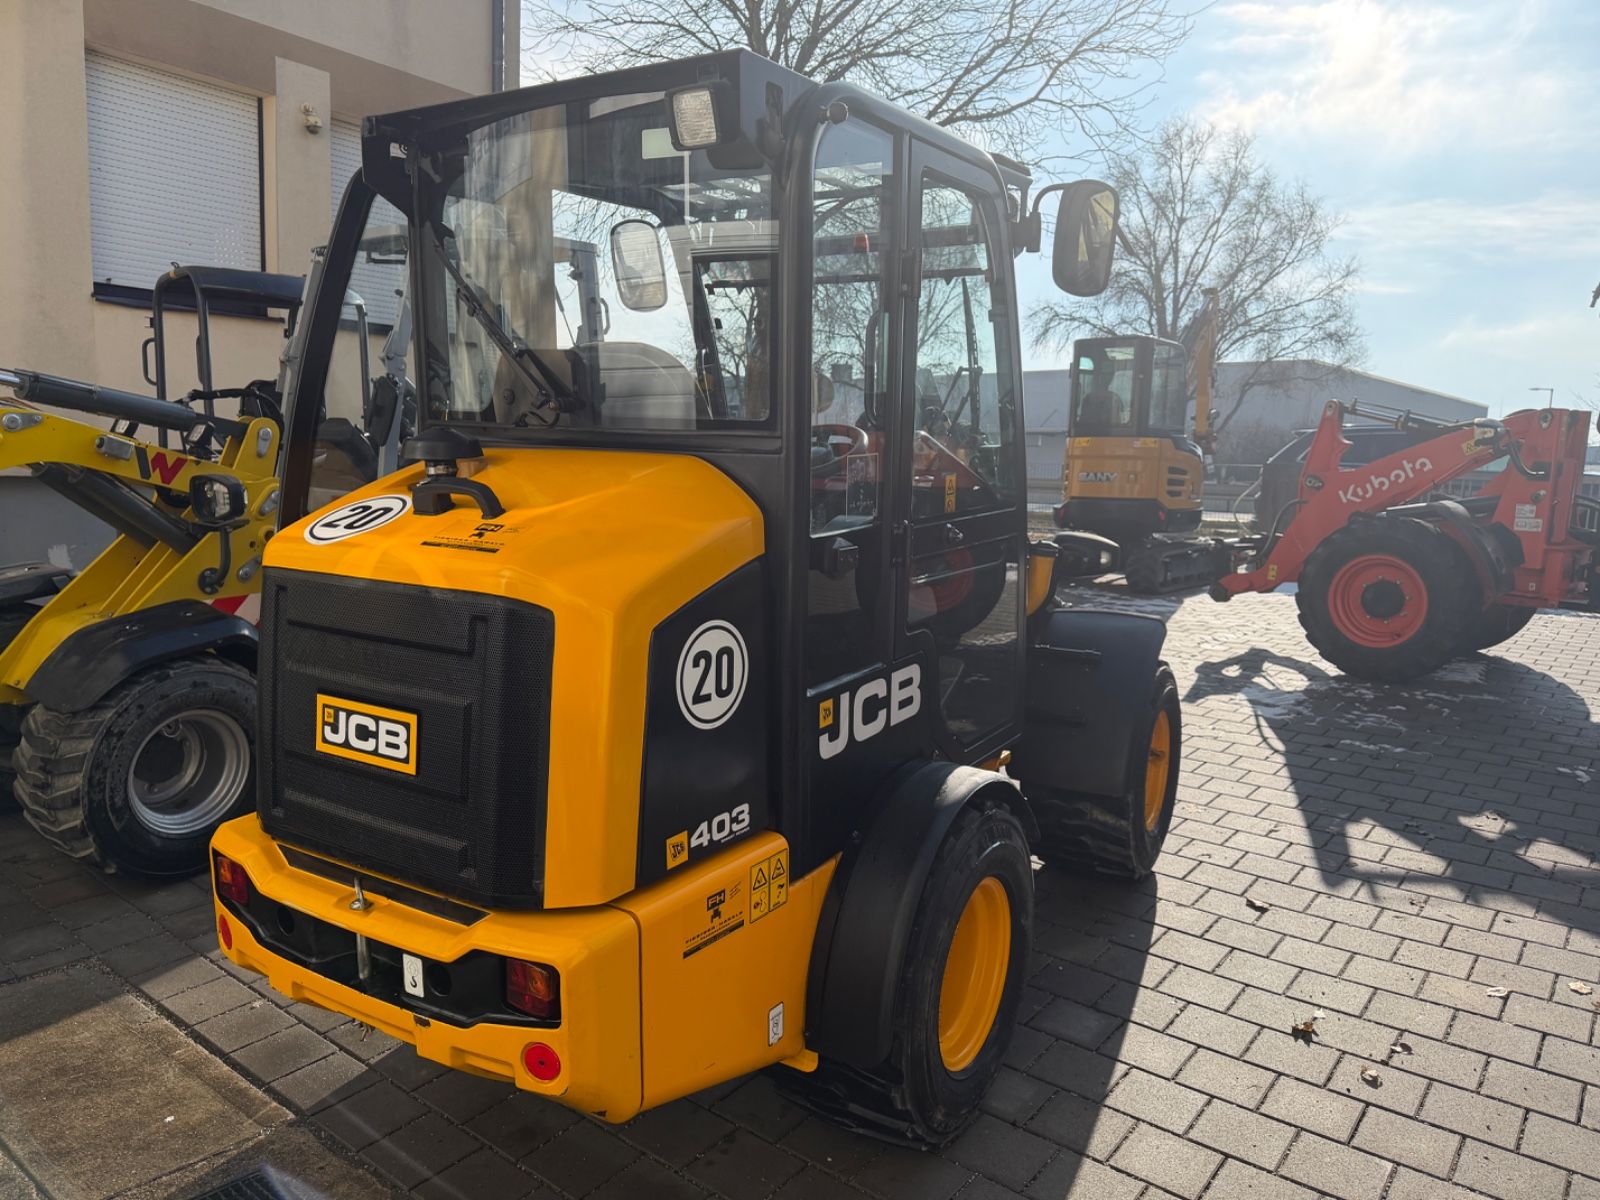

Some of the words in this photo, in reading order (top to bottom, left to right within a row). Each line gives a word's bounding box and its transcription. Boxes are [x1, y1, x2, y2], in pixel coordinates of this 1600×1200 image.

[1078, 472, 1118, 482] SANY
[1338, 457, 1432, 503] Kubota
[320, 505, 394, 529] 20
[692, 646, 734, 705] 20
[324, 709, 408, 759] JCB
[819, 663, 921, 760] JCB
[690, 803, 750, 848] 403
